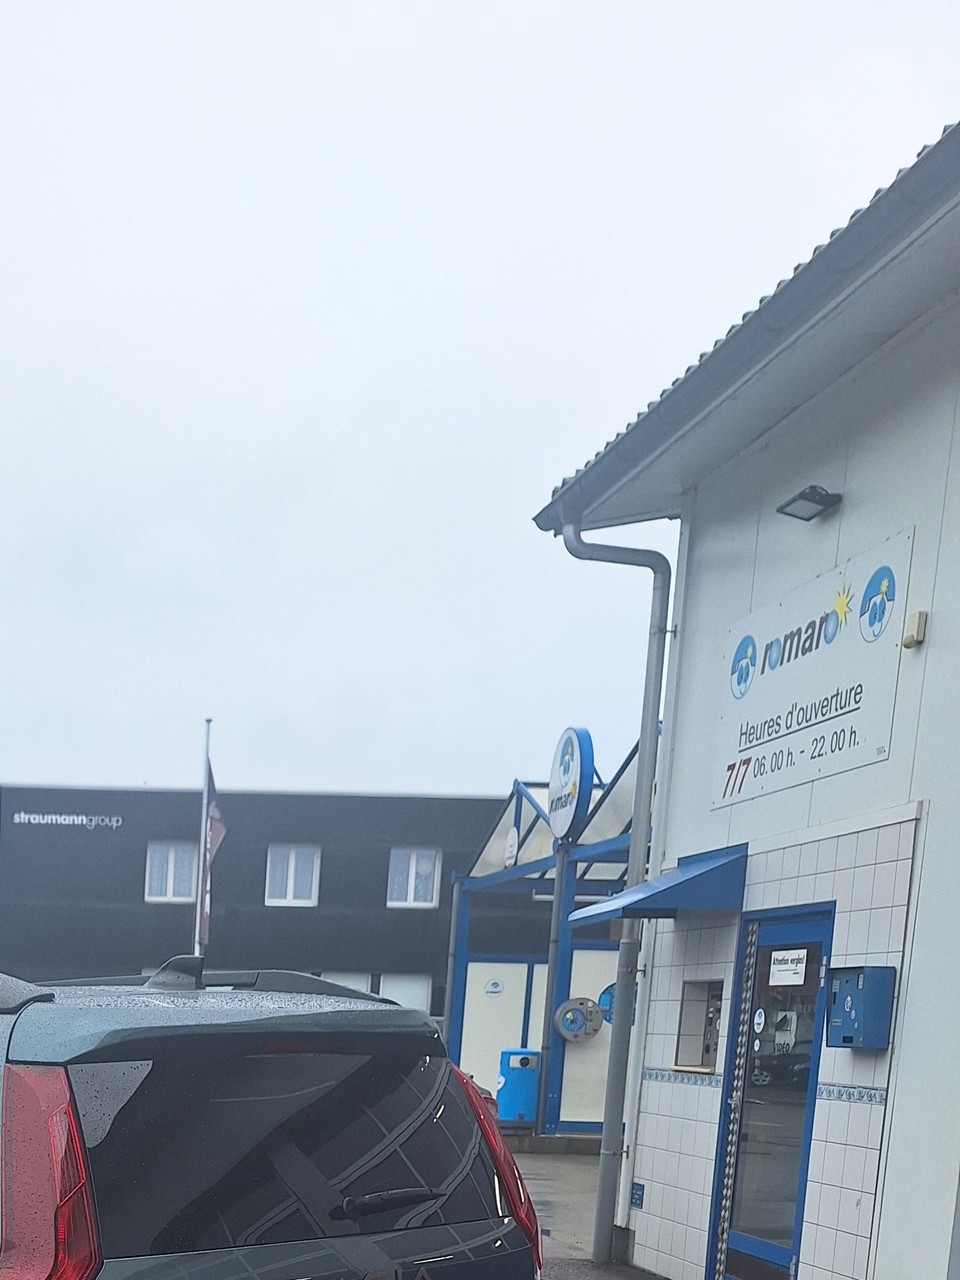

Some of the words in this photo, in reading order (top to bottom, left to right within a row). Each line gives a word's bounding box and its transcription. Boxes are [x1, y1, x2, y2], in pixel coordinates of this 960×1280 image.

[760, 609, 840, 676] romaro
[739, 714, 781, 748] Heures
[785, 683, 863, 731] d'ouverture
[722, 756, 753, 799] 7/7
[13, 811, 123, 831] straumanngroup
